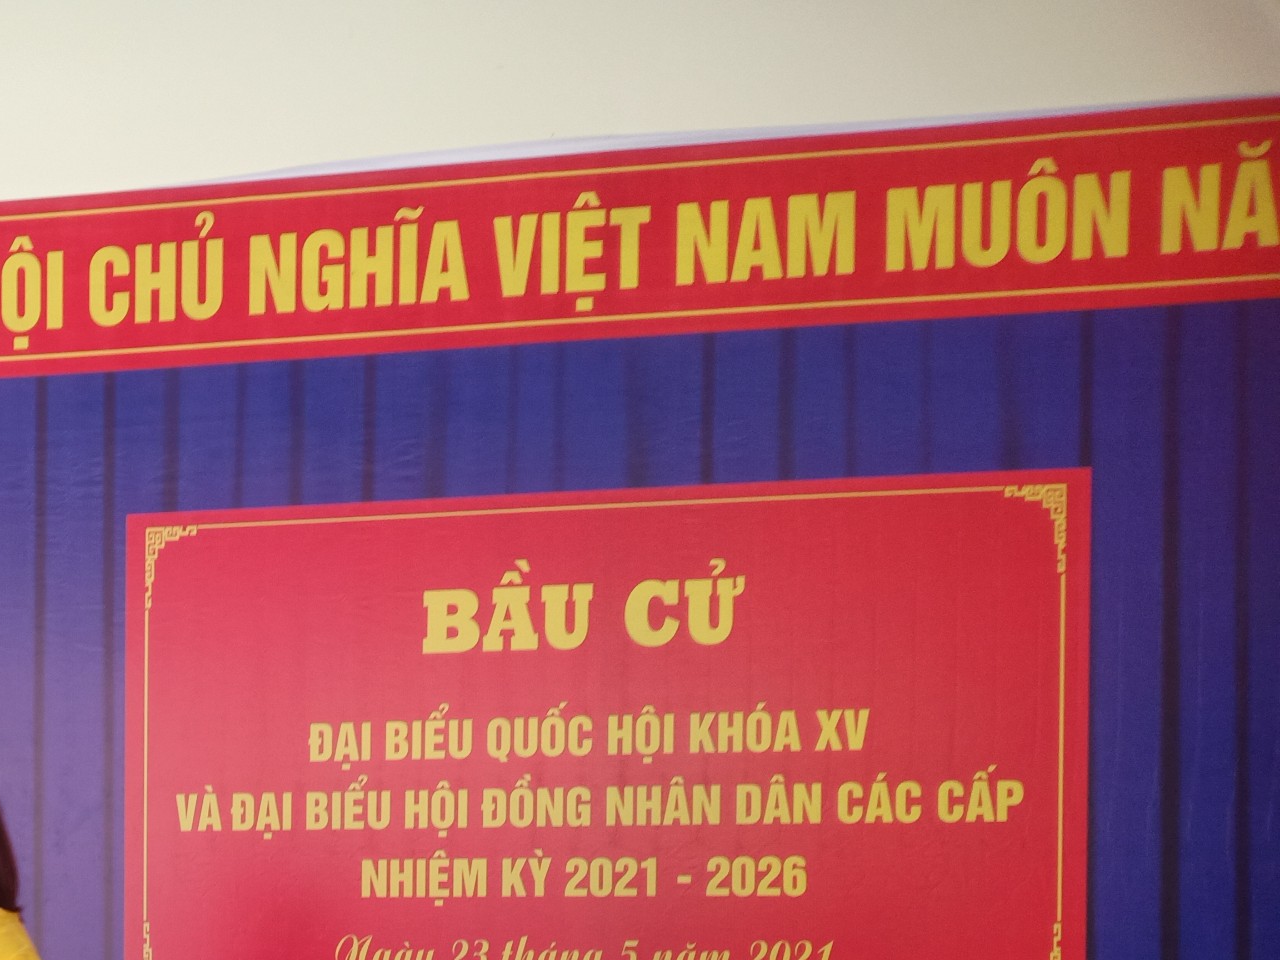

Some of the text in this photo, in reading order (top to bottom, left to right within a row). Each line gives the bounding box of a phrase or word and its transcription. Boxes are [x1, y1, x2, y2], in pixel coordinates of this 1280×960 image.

[89, 211, 223, 327] CHỦ
[249, 207, 469, 315] NGHĨA
[493, 192, 650, 312] VIỆT
[675, 190, 857, 286] NAM
[885, 157, 1131, 268] MUÔN
[422, 558, 745, 654] BẦU CỬ
[308, 701, 869, 766] ĐẠI BIỂU QUỐC HỘI KHÓA XV
[176, 764, 1023, 840] VÀ ĐẠI BIỂU HỘI ĐỒNG NHÂN DÂN CÁC CẤP
[361, 849, 806, 906] NHIỆM KỲ 2021 - 2026
